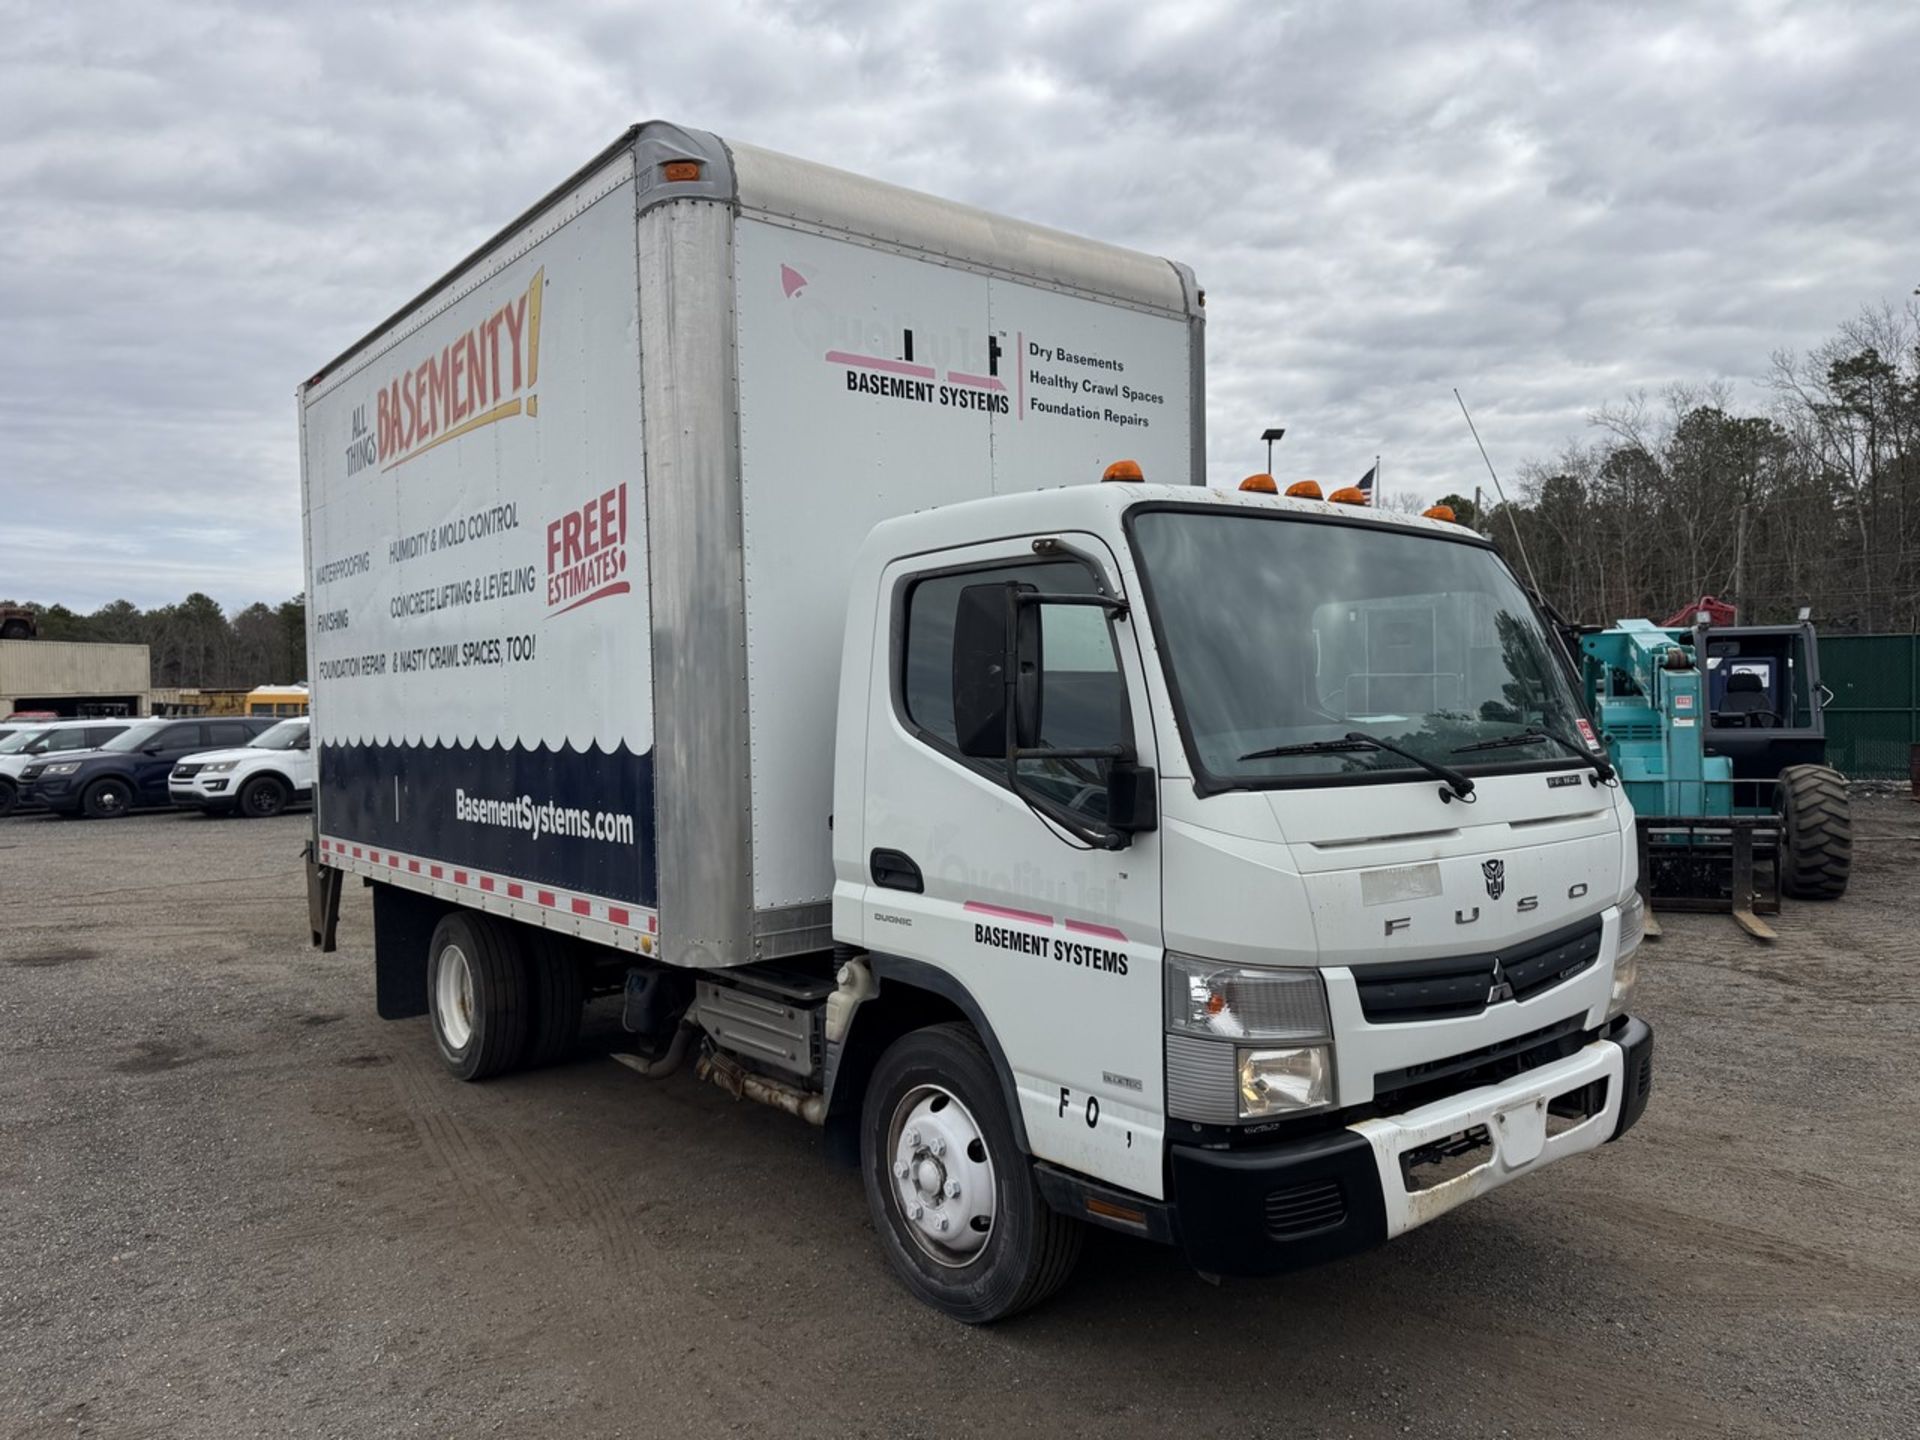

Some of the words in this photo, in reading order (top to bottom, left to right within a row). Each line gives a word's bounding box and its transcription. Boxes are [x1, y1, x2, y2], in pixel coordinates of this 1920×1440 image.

[1029, 342, 1052, 362] Dry
[1056, 348, 1124, 373] Basements
[847, 370, 935, 403] BASEMENT
[939, 385, 1009, 415] SYSTEMS
[1030, 370, 1079, 394] Healthy
[1082, 381, 1119, 400] Crawl
[1122, 389, 1164, 406] Spaces
[351, 403, 367, 441] ALL
[1030, 397, 1100, 423] Foundation
[1104, 410, 1149, 428] Repairs
[346, 432, 376, 477] THINGS
[389, 530, 429, 565] HUMIDITY
[430, 527, 437, 553] &
[438, 515, 467, 549] MOLD
[467, 502, 519, 540] CONTROL
[316, 551, 370, 586] WATERPROOFING
[390, 585, 437, 619] CONCRETE
[436, 584, 473, 611] LIFTING
[474, 585, 481, 602] &
[483, 565, 536, 600] LEVELING
[319, 657, 361, 680] FOUNDATION
[361, 653, 386, 676] REPAIR
[392, 652, 399, 673] &
[400, 647, 427, 672] NASTY
[428, 642, 460, 668] CRAWL
[461, 637, 504, 668] SPACES,
[506, 634, 537, 661] TOO!
[455, 788, 635, 845] BasementSystems.com
[874, 912, 912, 926] DUONIC
[1384, 882, 1589, 937] FUSO
[975, 923, 1049, 958] BASEMENT
[1053, 941, 1129, 975] SYSTEMS
